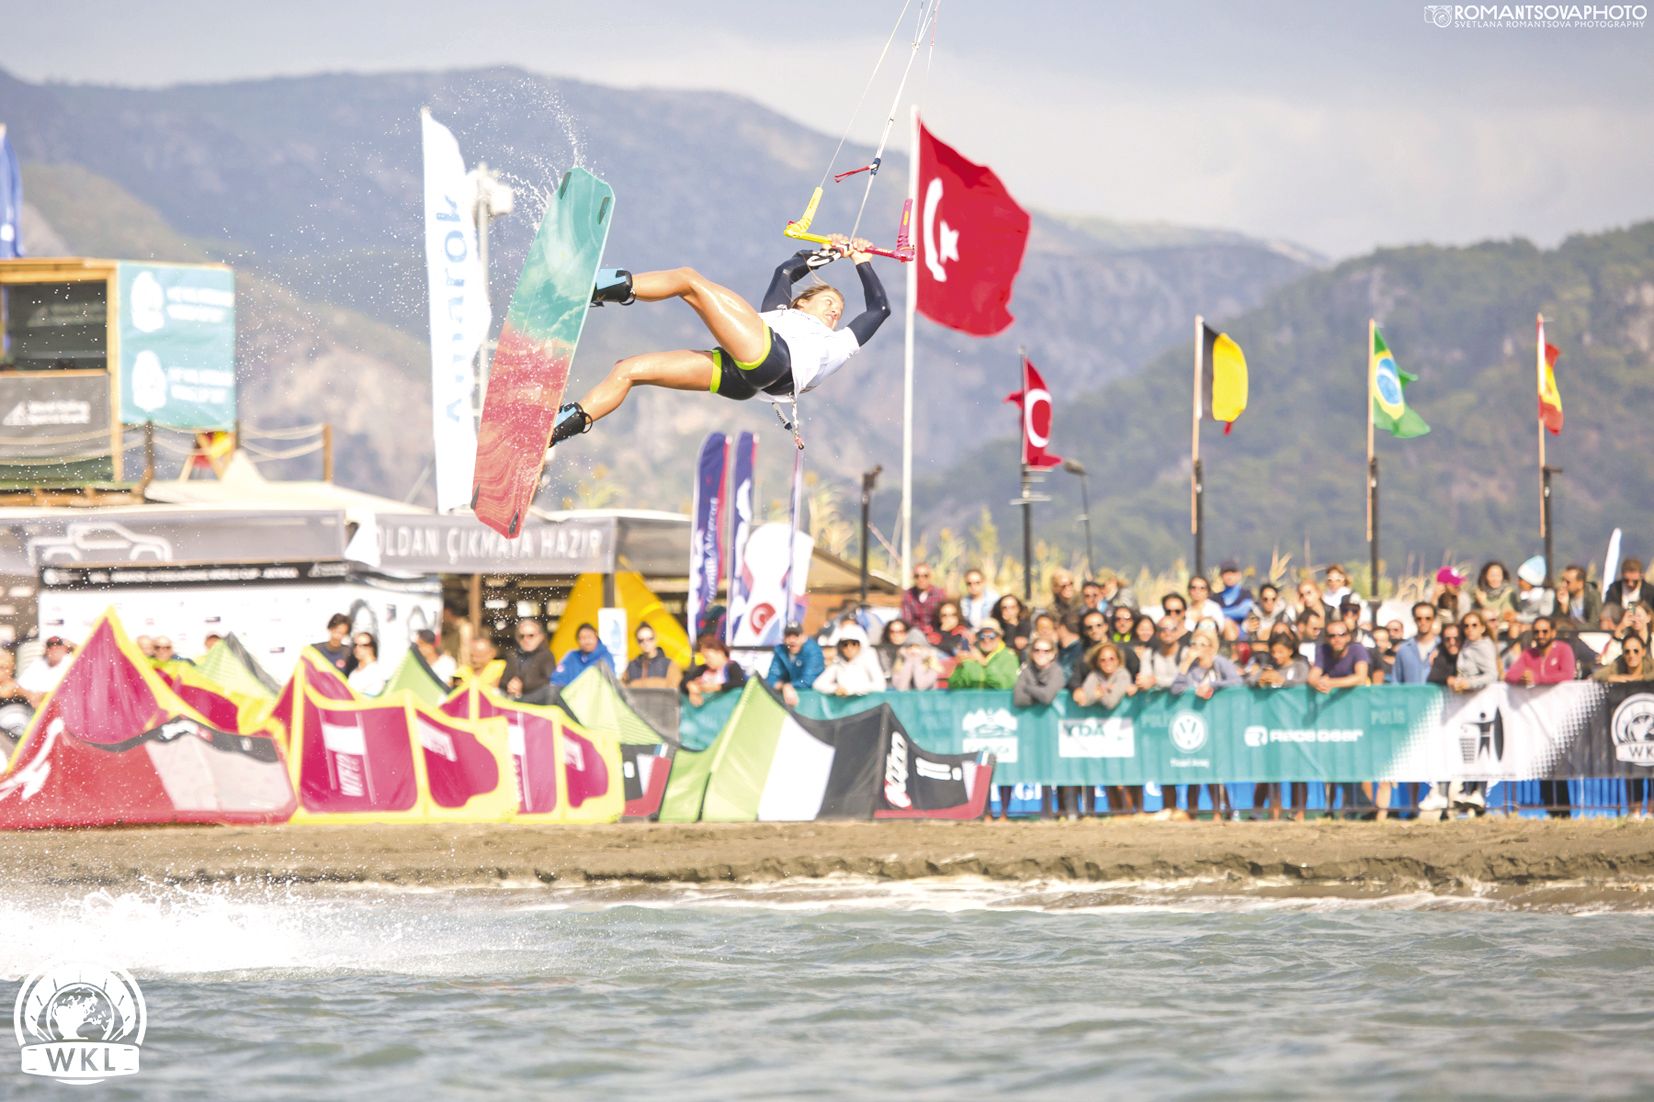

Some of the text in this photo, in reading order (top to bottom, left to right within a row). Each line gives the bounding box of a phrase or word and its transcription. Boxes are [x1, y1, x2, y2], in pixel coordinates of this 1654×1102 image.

[376, 527, 440, 557] OLDAN
[541, 529, 602, 559] HAZIR
[1629, 746, 1654, 759] WK
